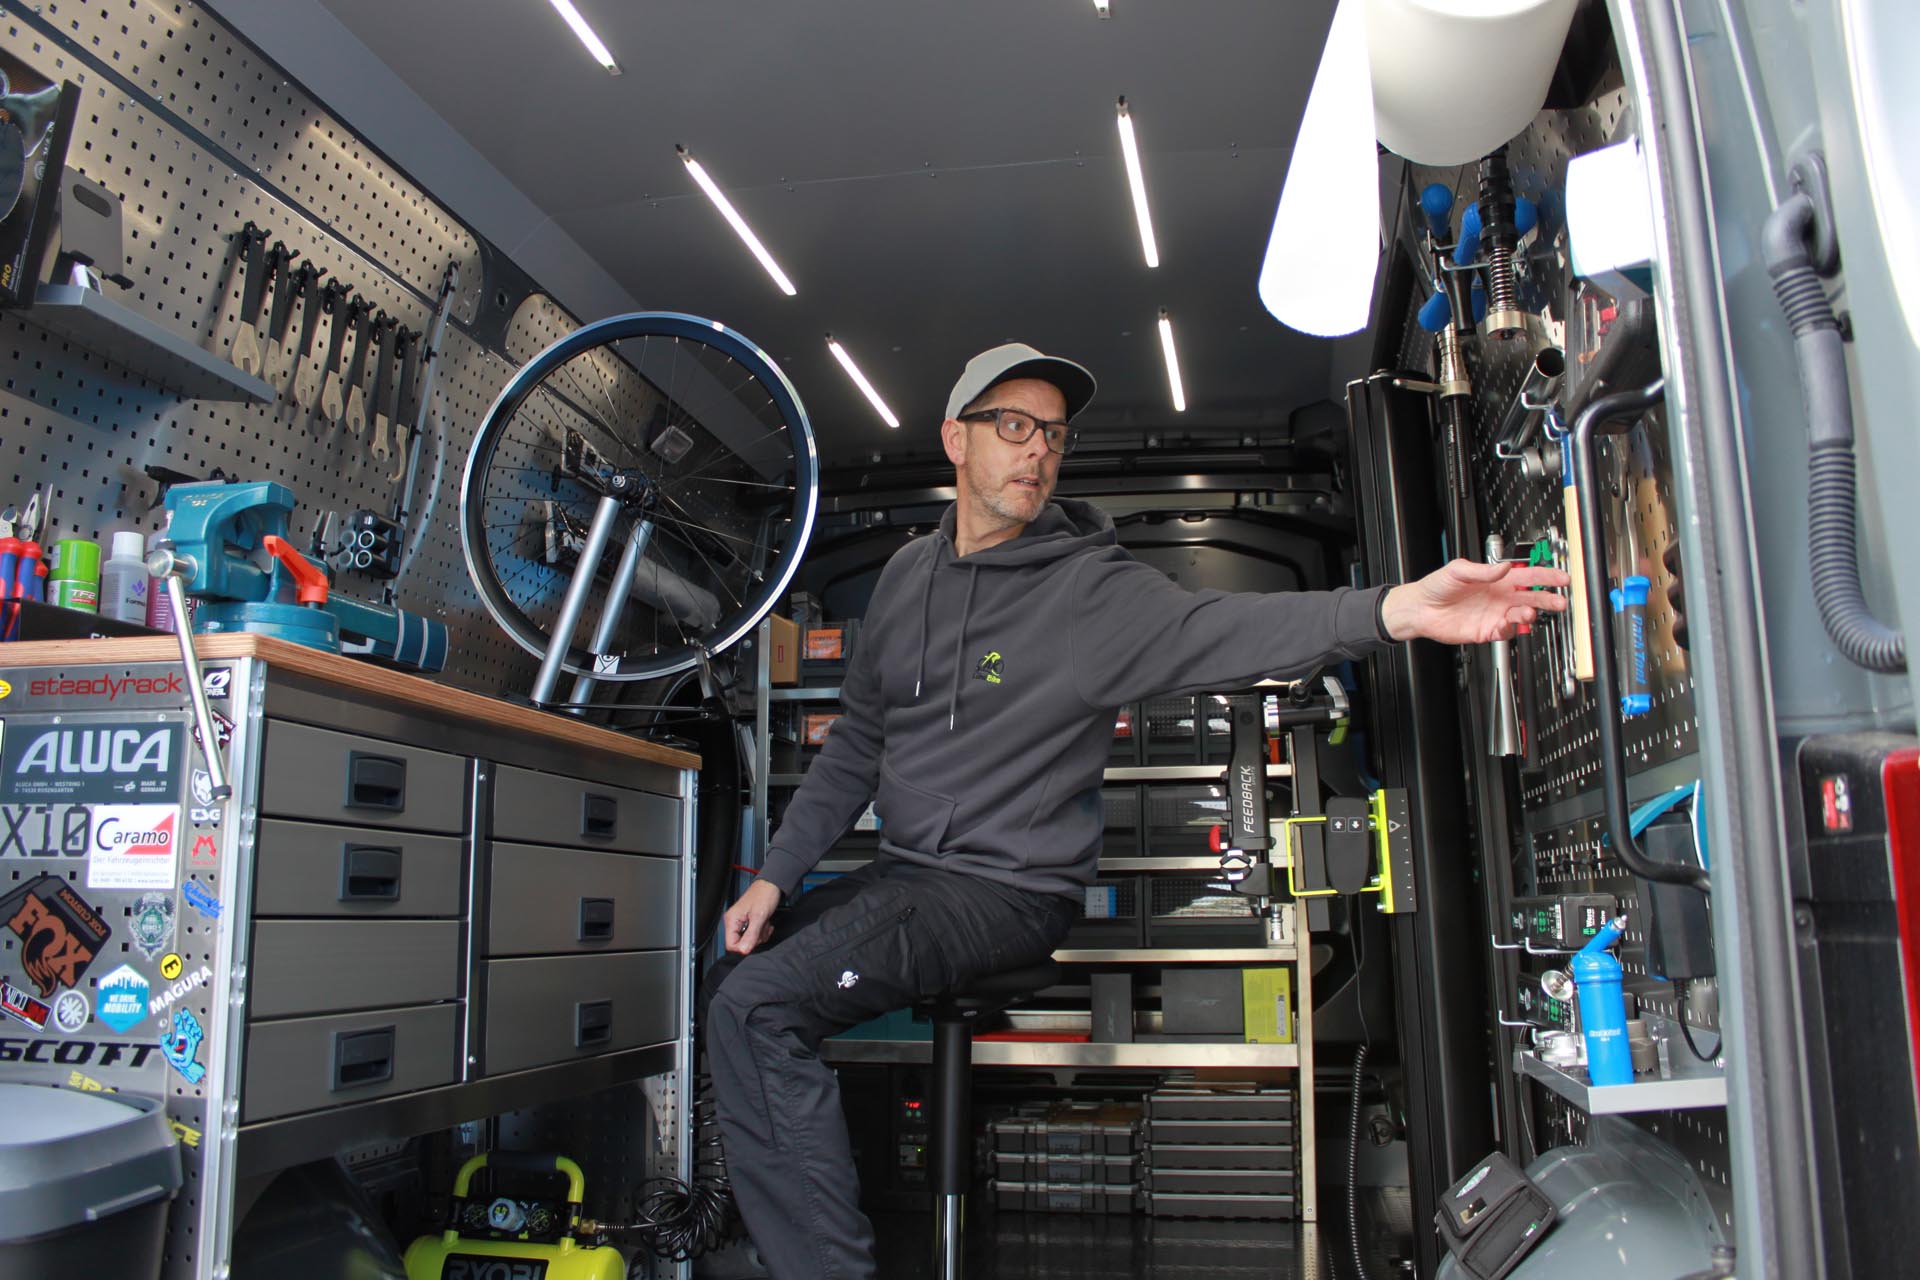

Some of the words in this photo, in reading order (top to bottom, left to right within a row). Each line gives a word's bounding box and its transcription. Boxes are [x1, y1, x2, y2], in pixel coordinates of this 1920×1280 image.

[1, 264, 12, 288] PRO
[30, 672, 184, 701] steadyrack
[16, 729, 171, 774] ALUCA
[1240, 765, 1255, 833] FEEDBACK
[96, 817, 169, 851] Caramo
[8, 892, 93, 997] FOX
[103, 1003, 142, 1014] MOBILITY
[149, 965, 213, 1015] MAGURA
